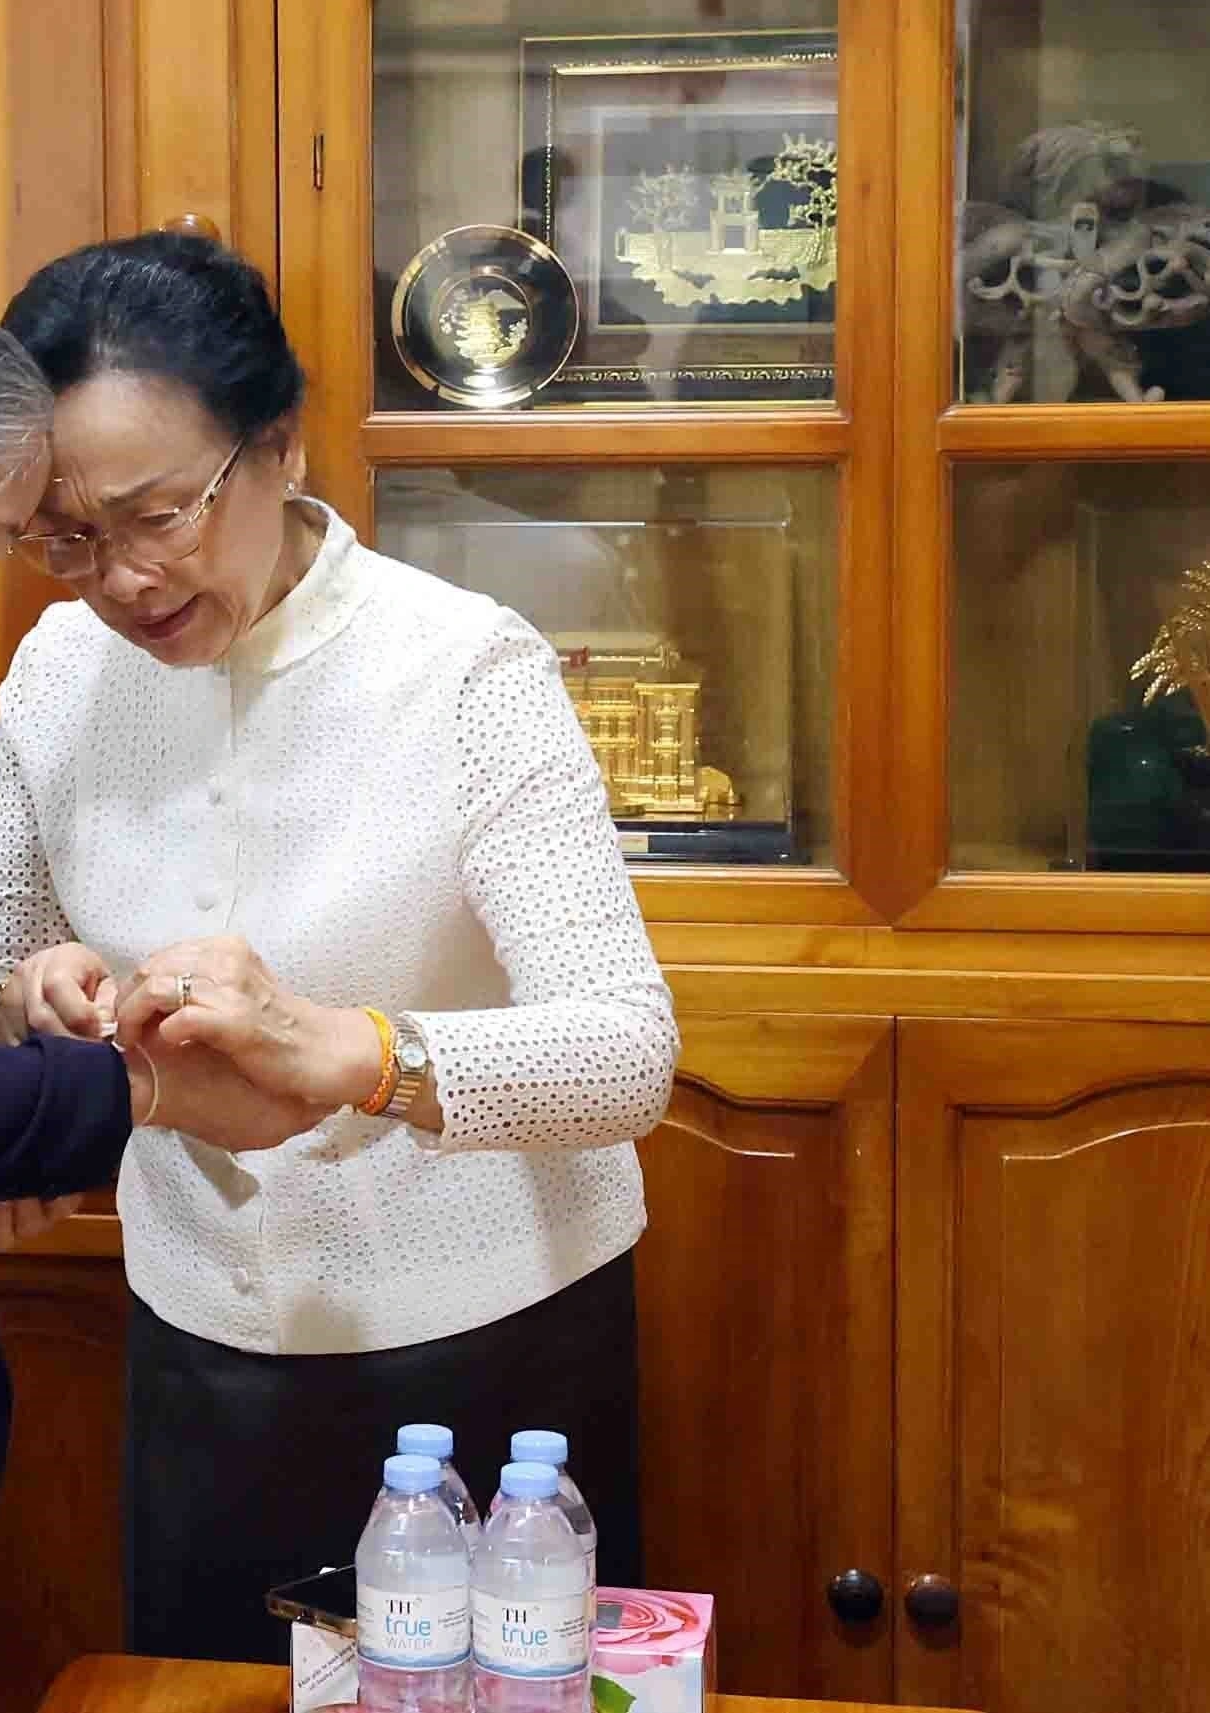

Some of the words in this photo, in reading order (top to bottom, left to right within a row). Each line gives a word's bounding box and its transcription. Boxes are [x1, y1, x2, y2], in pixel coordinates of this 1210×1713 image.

[384, 1598, 412, 1615] TH
[501, 1607, 528, 1625] TH
[385, 1615, 432, 1637] true
[501, 1623, 549, 1646] true
[385, 1637, 433, 1649] WATER
[502, 1647, 550, 1658] WATER
